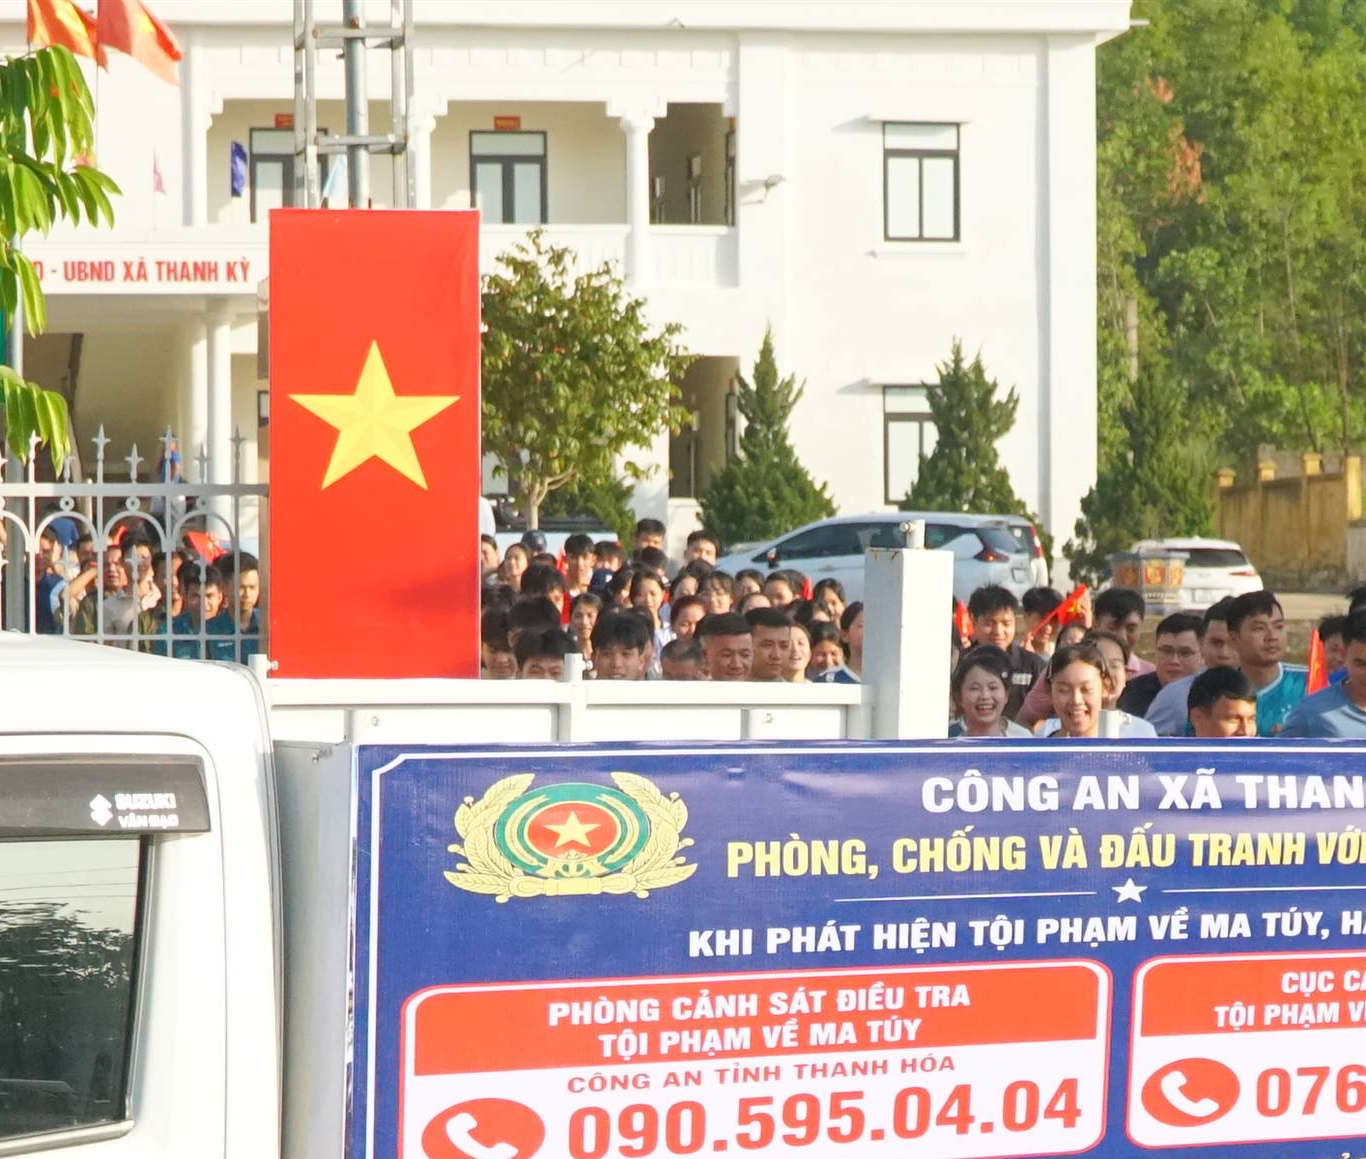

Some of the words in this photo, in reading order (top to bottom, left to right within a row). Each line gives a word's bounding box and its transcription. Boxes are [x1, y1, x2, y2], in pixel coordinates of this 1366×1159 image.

[63, 260, 115, 281] UBND
[155, 260, 218, 281] THANH
[922, 769, 1065, 813] CÔNG
[1073, 774, 1140, 810] AN
[1157, 768, 1224, 809] XÃ
[728, 833, 878, 879] PHÒNG,
[893, 826, 1025, 873] CHỐNG
[1040, 828, 1087, 869] VÀ
[1100, 822, 1175, 867] ĐẤU
[1188, 832, 1305, 867] TRANH
[690, 929, 752, 957] KHI
[767, 920, 861, 953] PHÁT
[874, 918, 956, 953] HIỆN
[969, 915, 1024, 955] TỘI
[1037, 916, 1136, 947] PHẠM
[1149, 907, 1189, 939] VỀ
[1201, 913, 1251, 938] MA
[1262, 907, 1329, 939] TÚY,
[549, 996, 659, 1026] PHÒNG
[672, 989, 757, 1020] CẢNH
[769, 987, 826, 1015] SÁT
[837, 981, 904, 1011] ĐIỀU
[915, 985, 970, 1008] TRA
[1282, 971, 1334, 997] CỤC
[598, 1029, 648, 1061] TỘI
[660, 1027, 751, 1056] PHẠM
[762, 1018, 798, 1048] VỀ
[810, 1022, 857, 1045] MA
[867, 1015, 921, 1042] TÚY
[1215, 1002, 1255, 1031] TỘI
[1264, 1002, 1339, 1028] PHẠM
[568, 1067, 650, 1092] CÔNG
[666, 1067, 701, 1086] AN
[712, 1061, 780, 1083] TỈNH
[796, 1061, 888, 1077] THANH
[901, 1056, 953, 1077] HÓA
